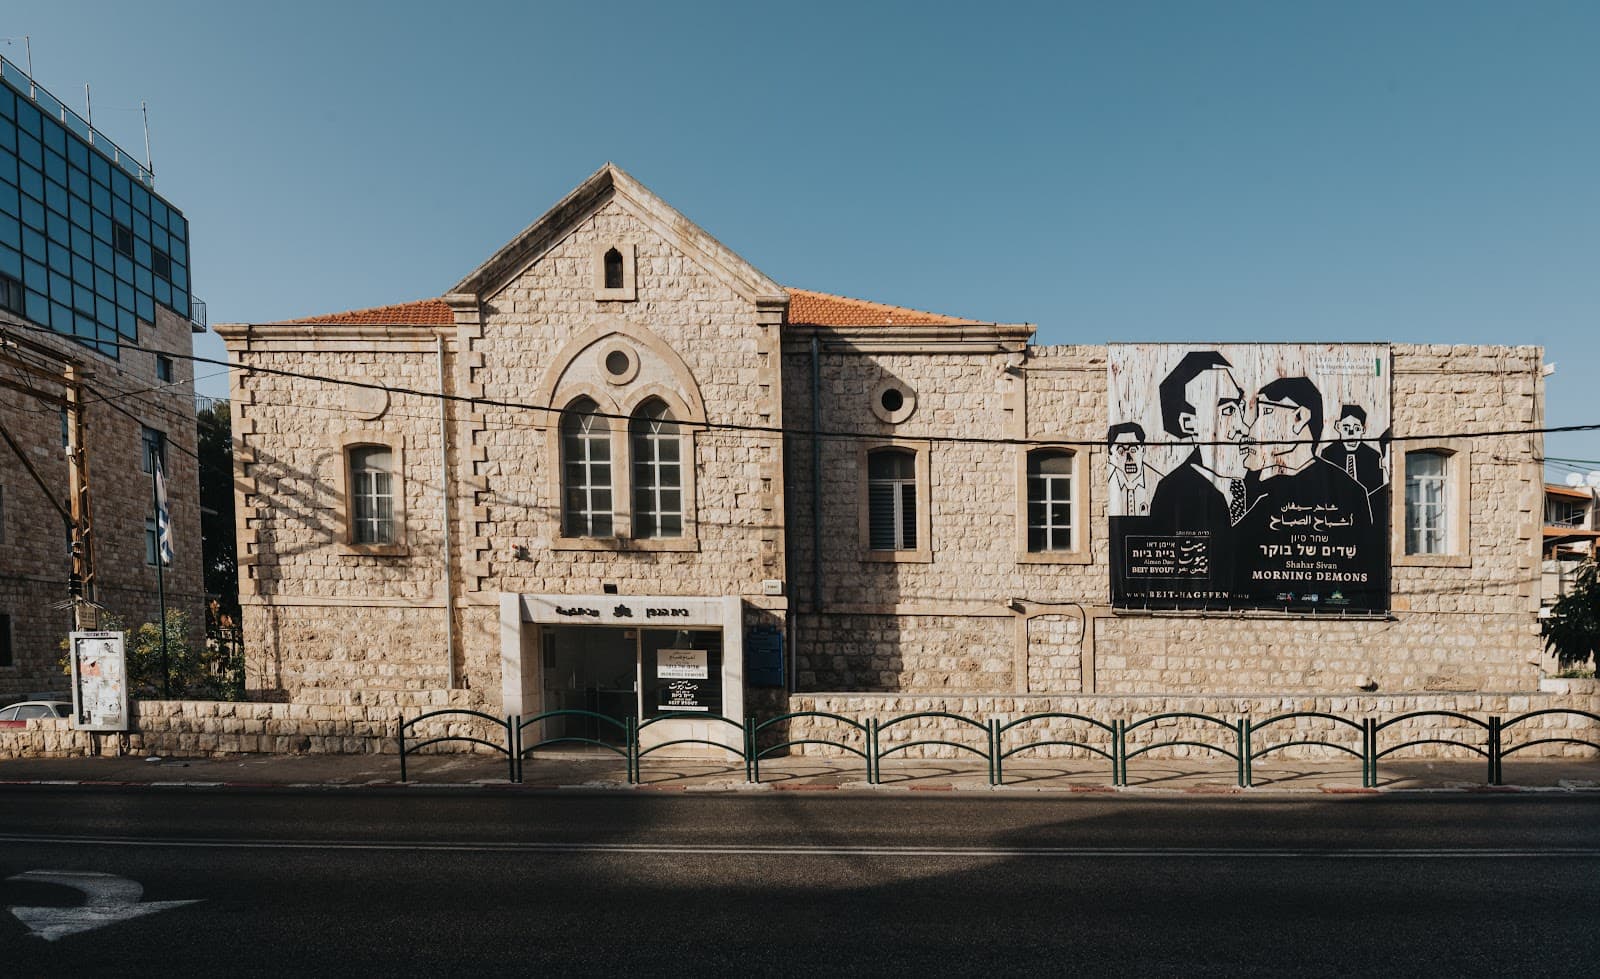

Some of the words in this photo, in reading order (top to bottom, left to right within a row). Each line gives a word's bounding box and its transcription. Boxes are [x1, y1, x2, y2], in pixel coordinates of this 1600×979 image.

[1269, 513, 1312, 531] الصباح
[1290, 534, 1307, 544] סיון
[1309, 534, 1329, 543] שחר
[1259, 544, 1293, 558] בוקר
[1296, 543, 1317, 556] של
[1149, 566, 1175, 574] BYOUT
[1285, 560, 1315, 570] Shahar
[1315, 561, 1338, 571] Sivan
[1252, 570, 1313, 581] MORNING
[1316, 571, 1368, 582] DEMONS
[670, 607, 690, 617] בית
